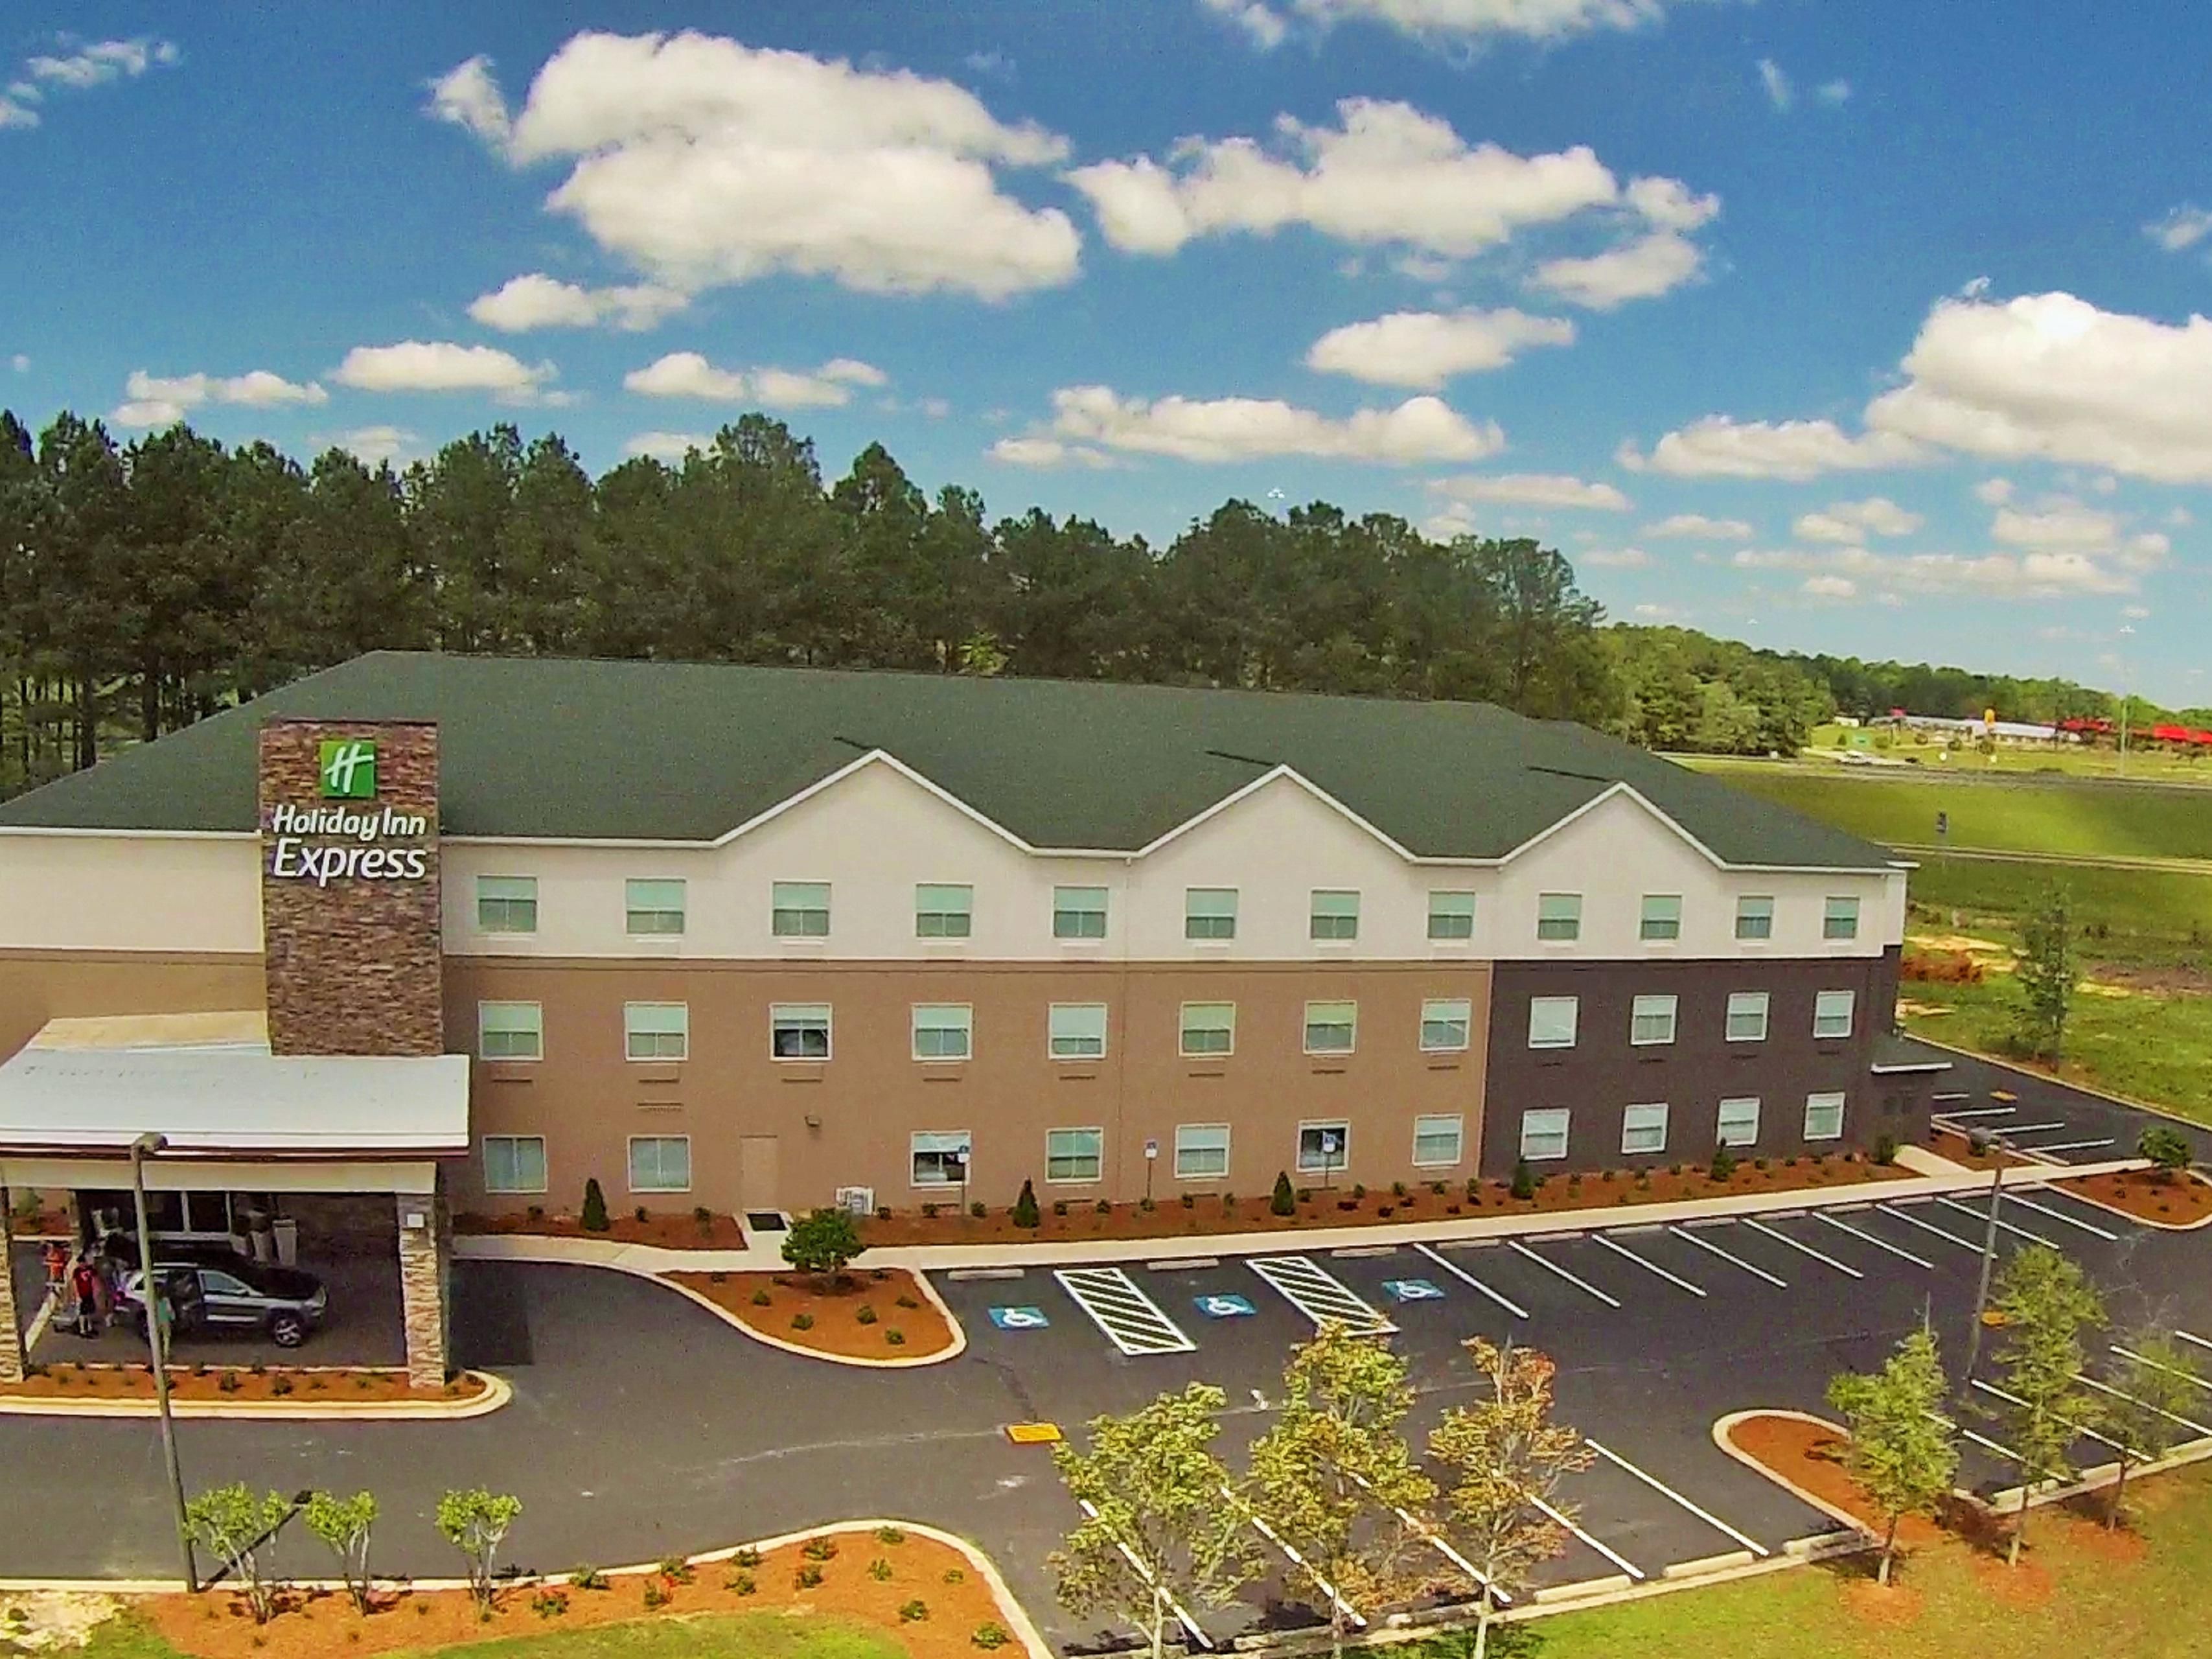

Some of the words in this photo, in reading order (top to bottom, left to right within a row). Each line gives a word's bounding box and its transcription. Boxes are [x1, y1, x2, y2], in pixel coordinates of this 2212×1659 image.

[273, 804, 379, 841] Holiday
[382, 807, 426, 835] Inn
[273, 838, 427, 887] Express
